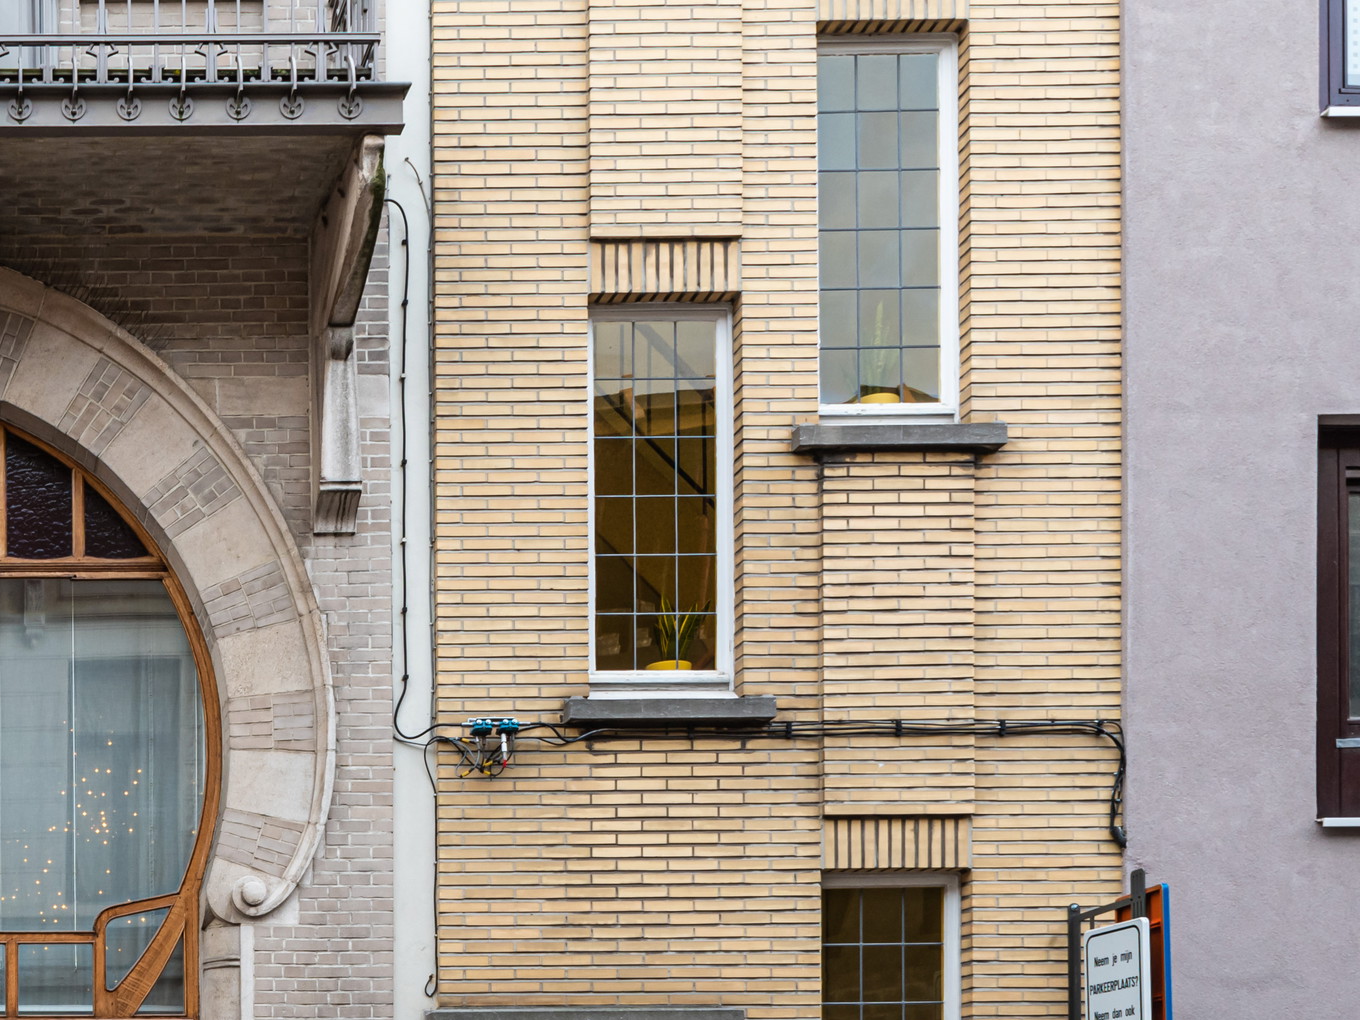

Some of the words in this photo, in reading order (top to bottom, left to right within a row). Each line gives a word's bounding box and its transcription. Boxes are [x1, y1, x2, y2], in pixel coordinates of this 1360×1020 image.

[1094, 957, 1109, 967] Neem
[1112, 953, 1117, 966] je
[1120, 950, 1132, 963] mijn
[1089, 976, 1138, 995] PARKEERPLAATS?
[1112, 1008, 1122, 1019] dan
[1125, 1004, 1135, 1017] ook
